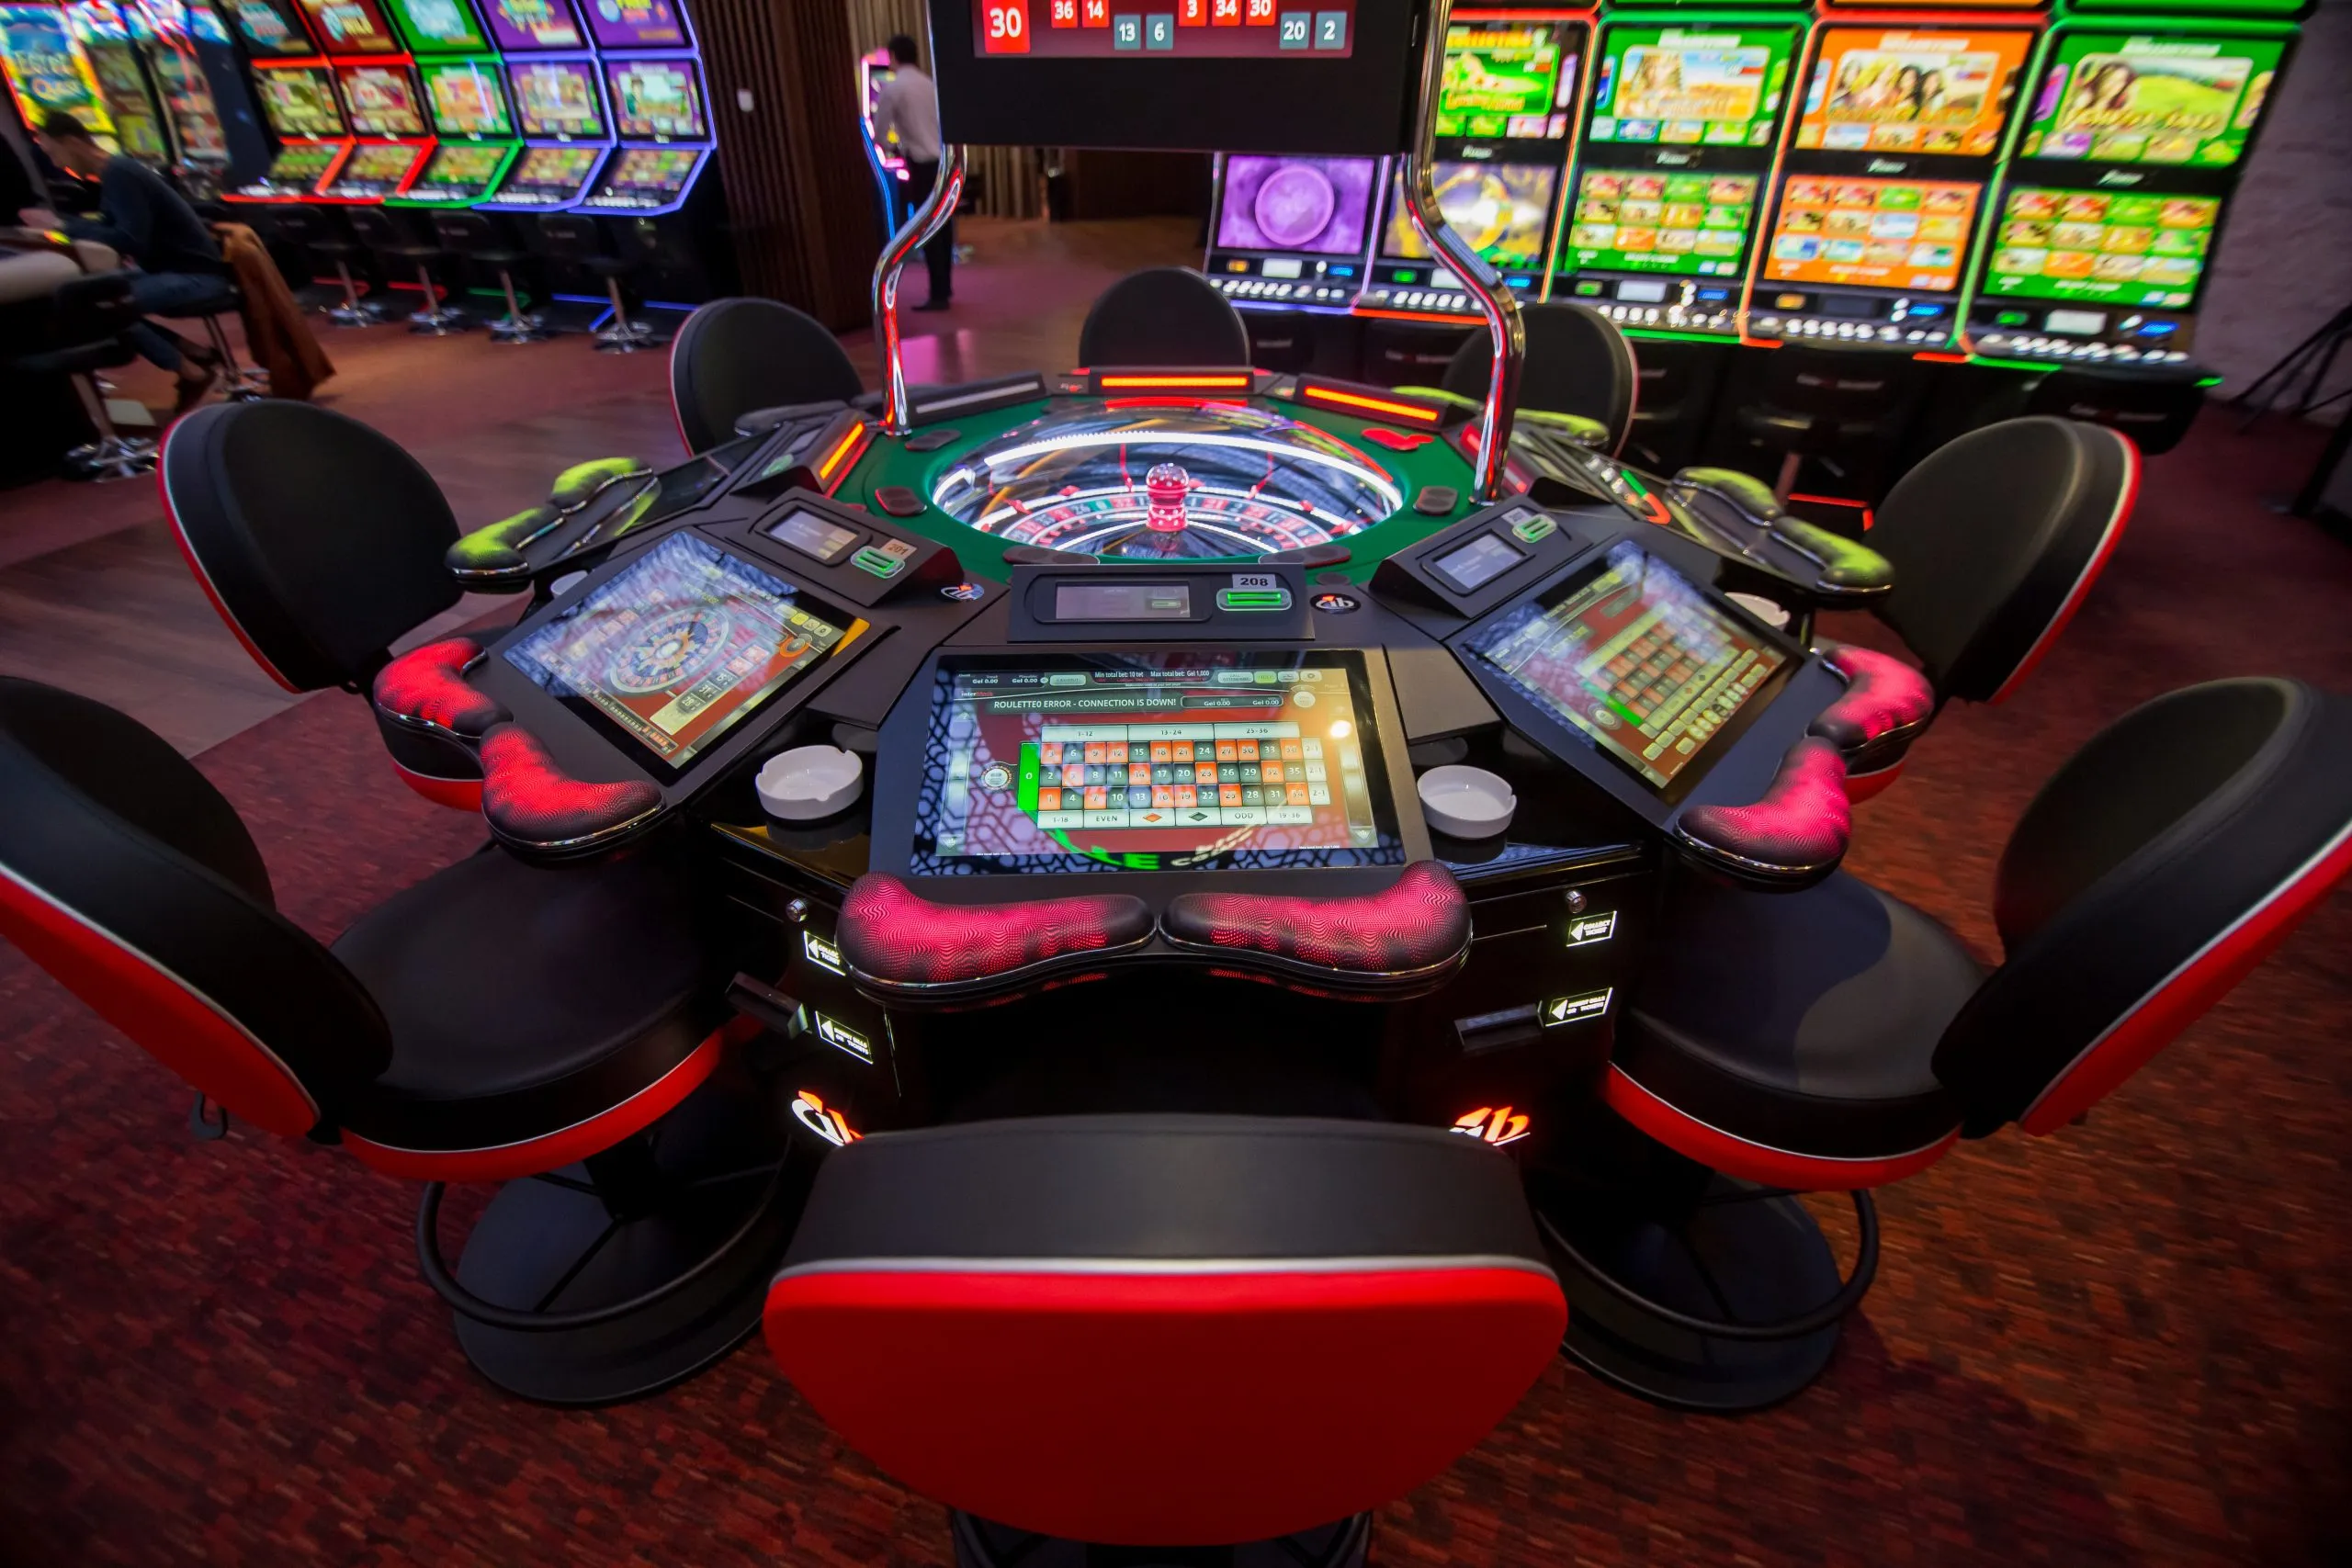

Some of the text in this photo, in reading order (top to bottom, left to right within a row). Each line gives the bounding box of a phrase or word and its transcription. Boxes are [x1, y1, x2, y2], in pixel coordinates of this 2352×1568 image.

[1055, 0, 1103, 19] 36 14
[1187, 0, 1272, 17] 3 34 30
[989, 7, 1022, 38] 30
[1119, 22, 1165, 41] 13 6
[1283, 20, 1336, 40] 20 2
[1240, 578, 1269, 586] 208
[682, 696, 695, 706] 28
[1078, 699, 1135, 707] CONNECTION
[1146, 698, 1177, 706] DOWN!
[1201, 769, 1212, 777] 23
[1244, 768, 1257, 776] 29
[1247, 791, 1259, 799] 28
